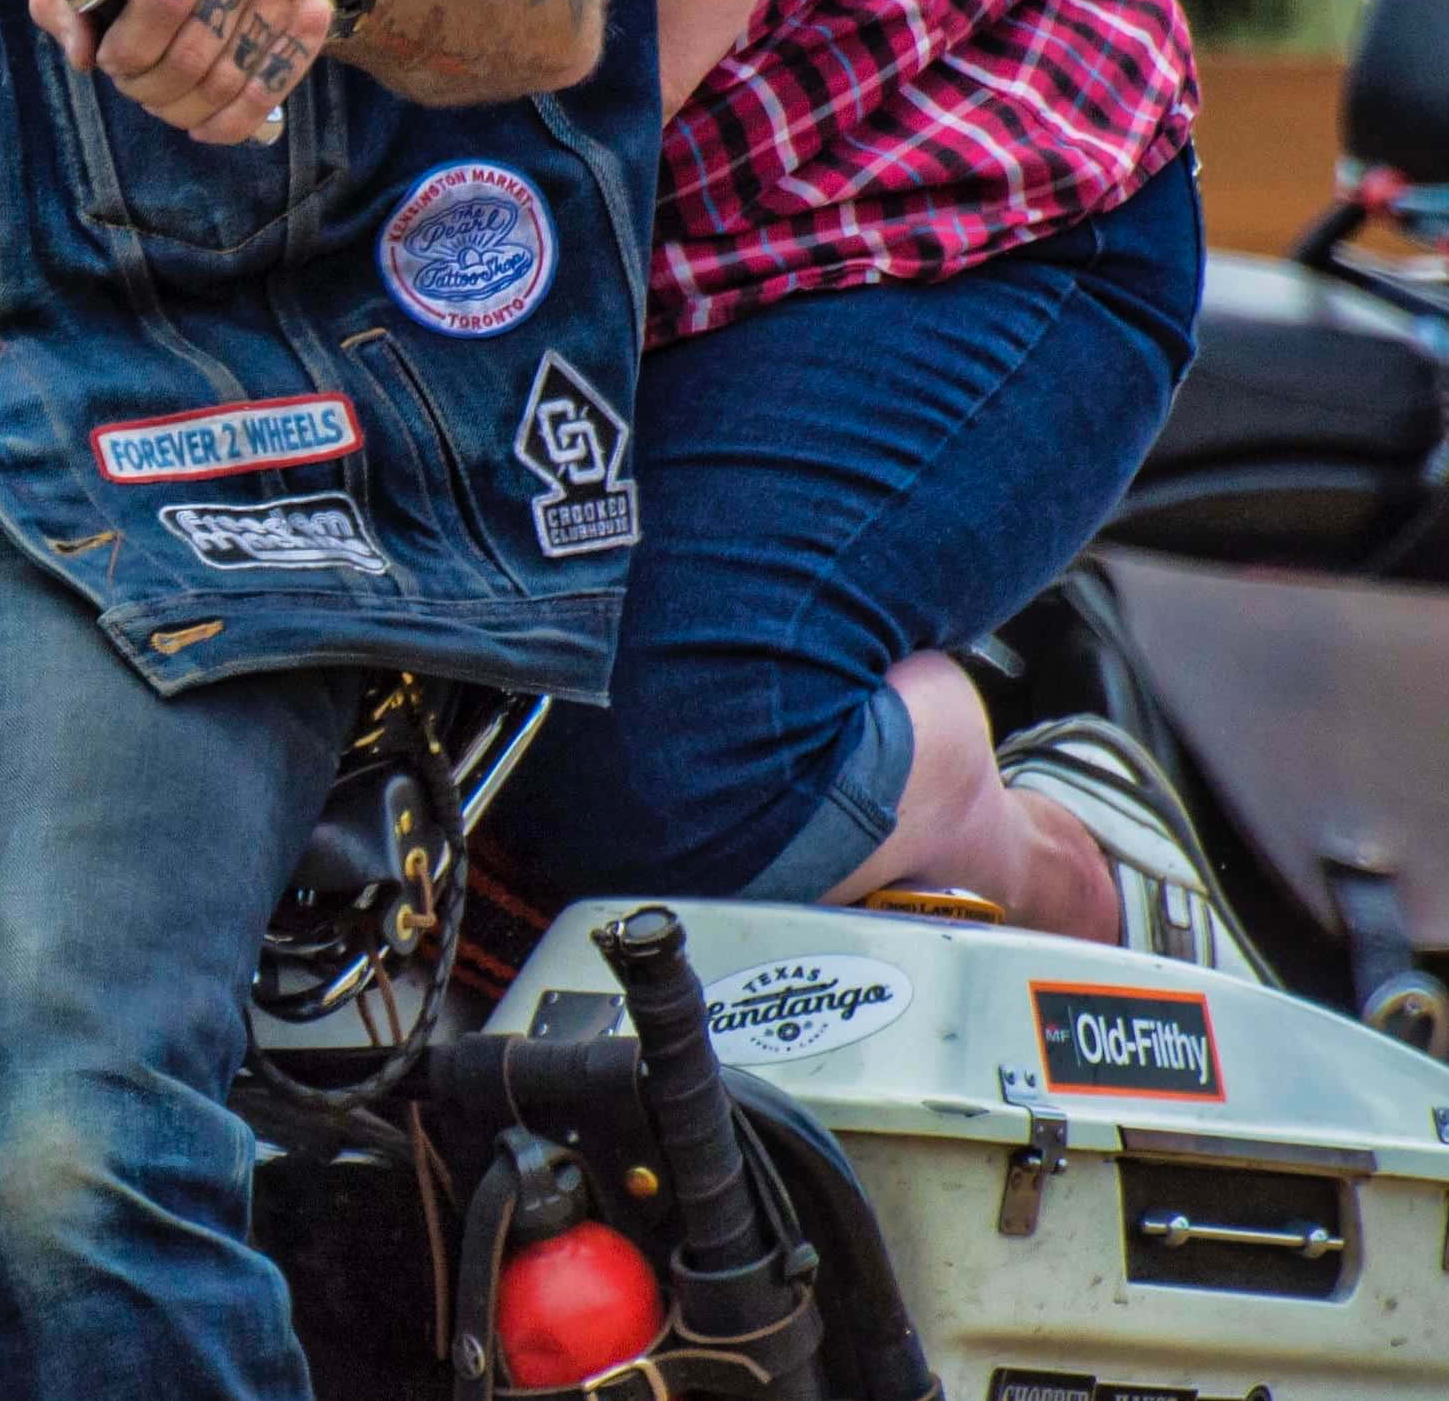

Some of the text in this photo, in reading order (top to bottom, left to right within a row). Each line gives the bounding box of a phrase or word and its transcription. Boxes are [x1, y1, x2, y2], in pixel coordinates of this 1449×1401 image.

[471, 169, 534, 206] MARKET
[421, 265, 486, 288] Tattoo
[447, 298, 525, 328] TORONTO
[110, 409, 344, 471] FOREVER 2 WHEELS
[547, 495, 627, 528] CROOKED
[743, 966, 820, 994] TEXAS
[1076, 1012, 1208, 1085] Old-Filthy
